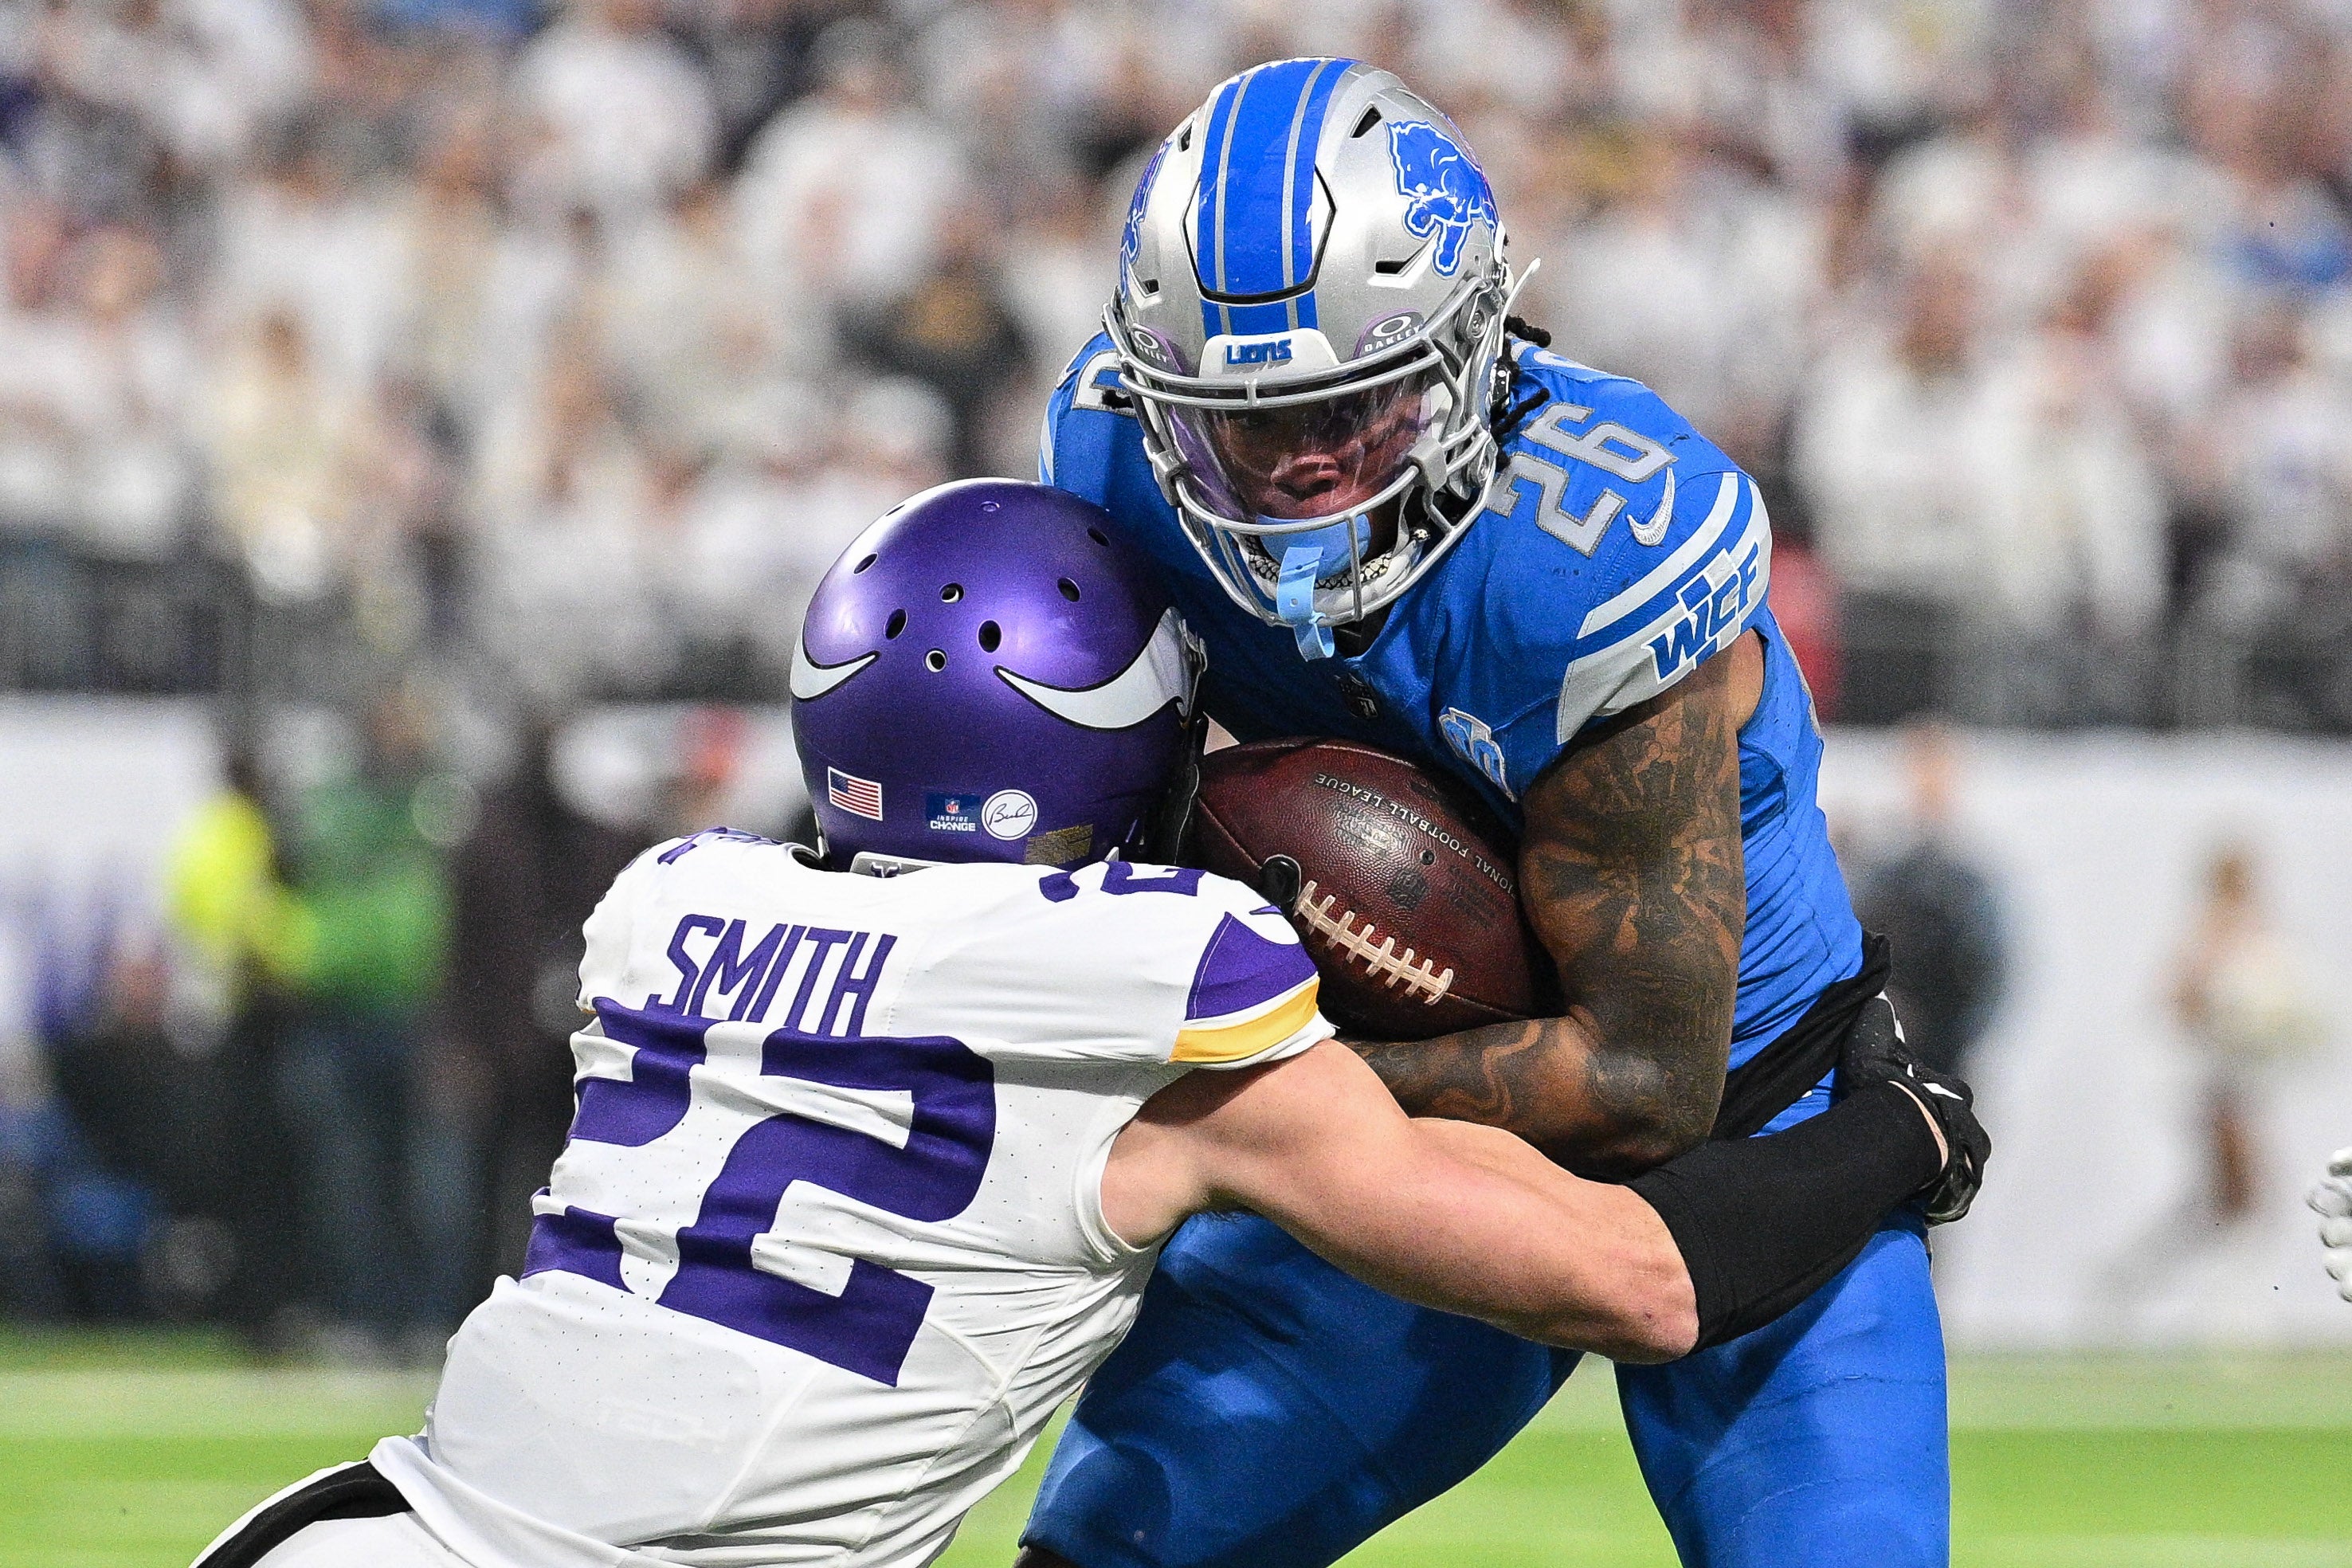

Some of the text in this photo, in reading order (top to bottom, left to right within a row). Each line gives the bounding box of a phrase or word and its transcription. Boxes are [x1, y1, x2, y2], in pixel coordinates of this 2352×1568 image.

[1363, 323, 1421, 353] OAKLEY
[1484, 401, 1679, 559] 26
[1645, 539, 1760, 683] WCF
[930, 820, 976, 831] CHANGE
[1315, 773, 1383, 808] LEAGUE
[1390, 802, 1469, 859] FOOTBALL
[642, 913, 898, 1037] SMITH
[518, 997, 998, 1387] 22
